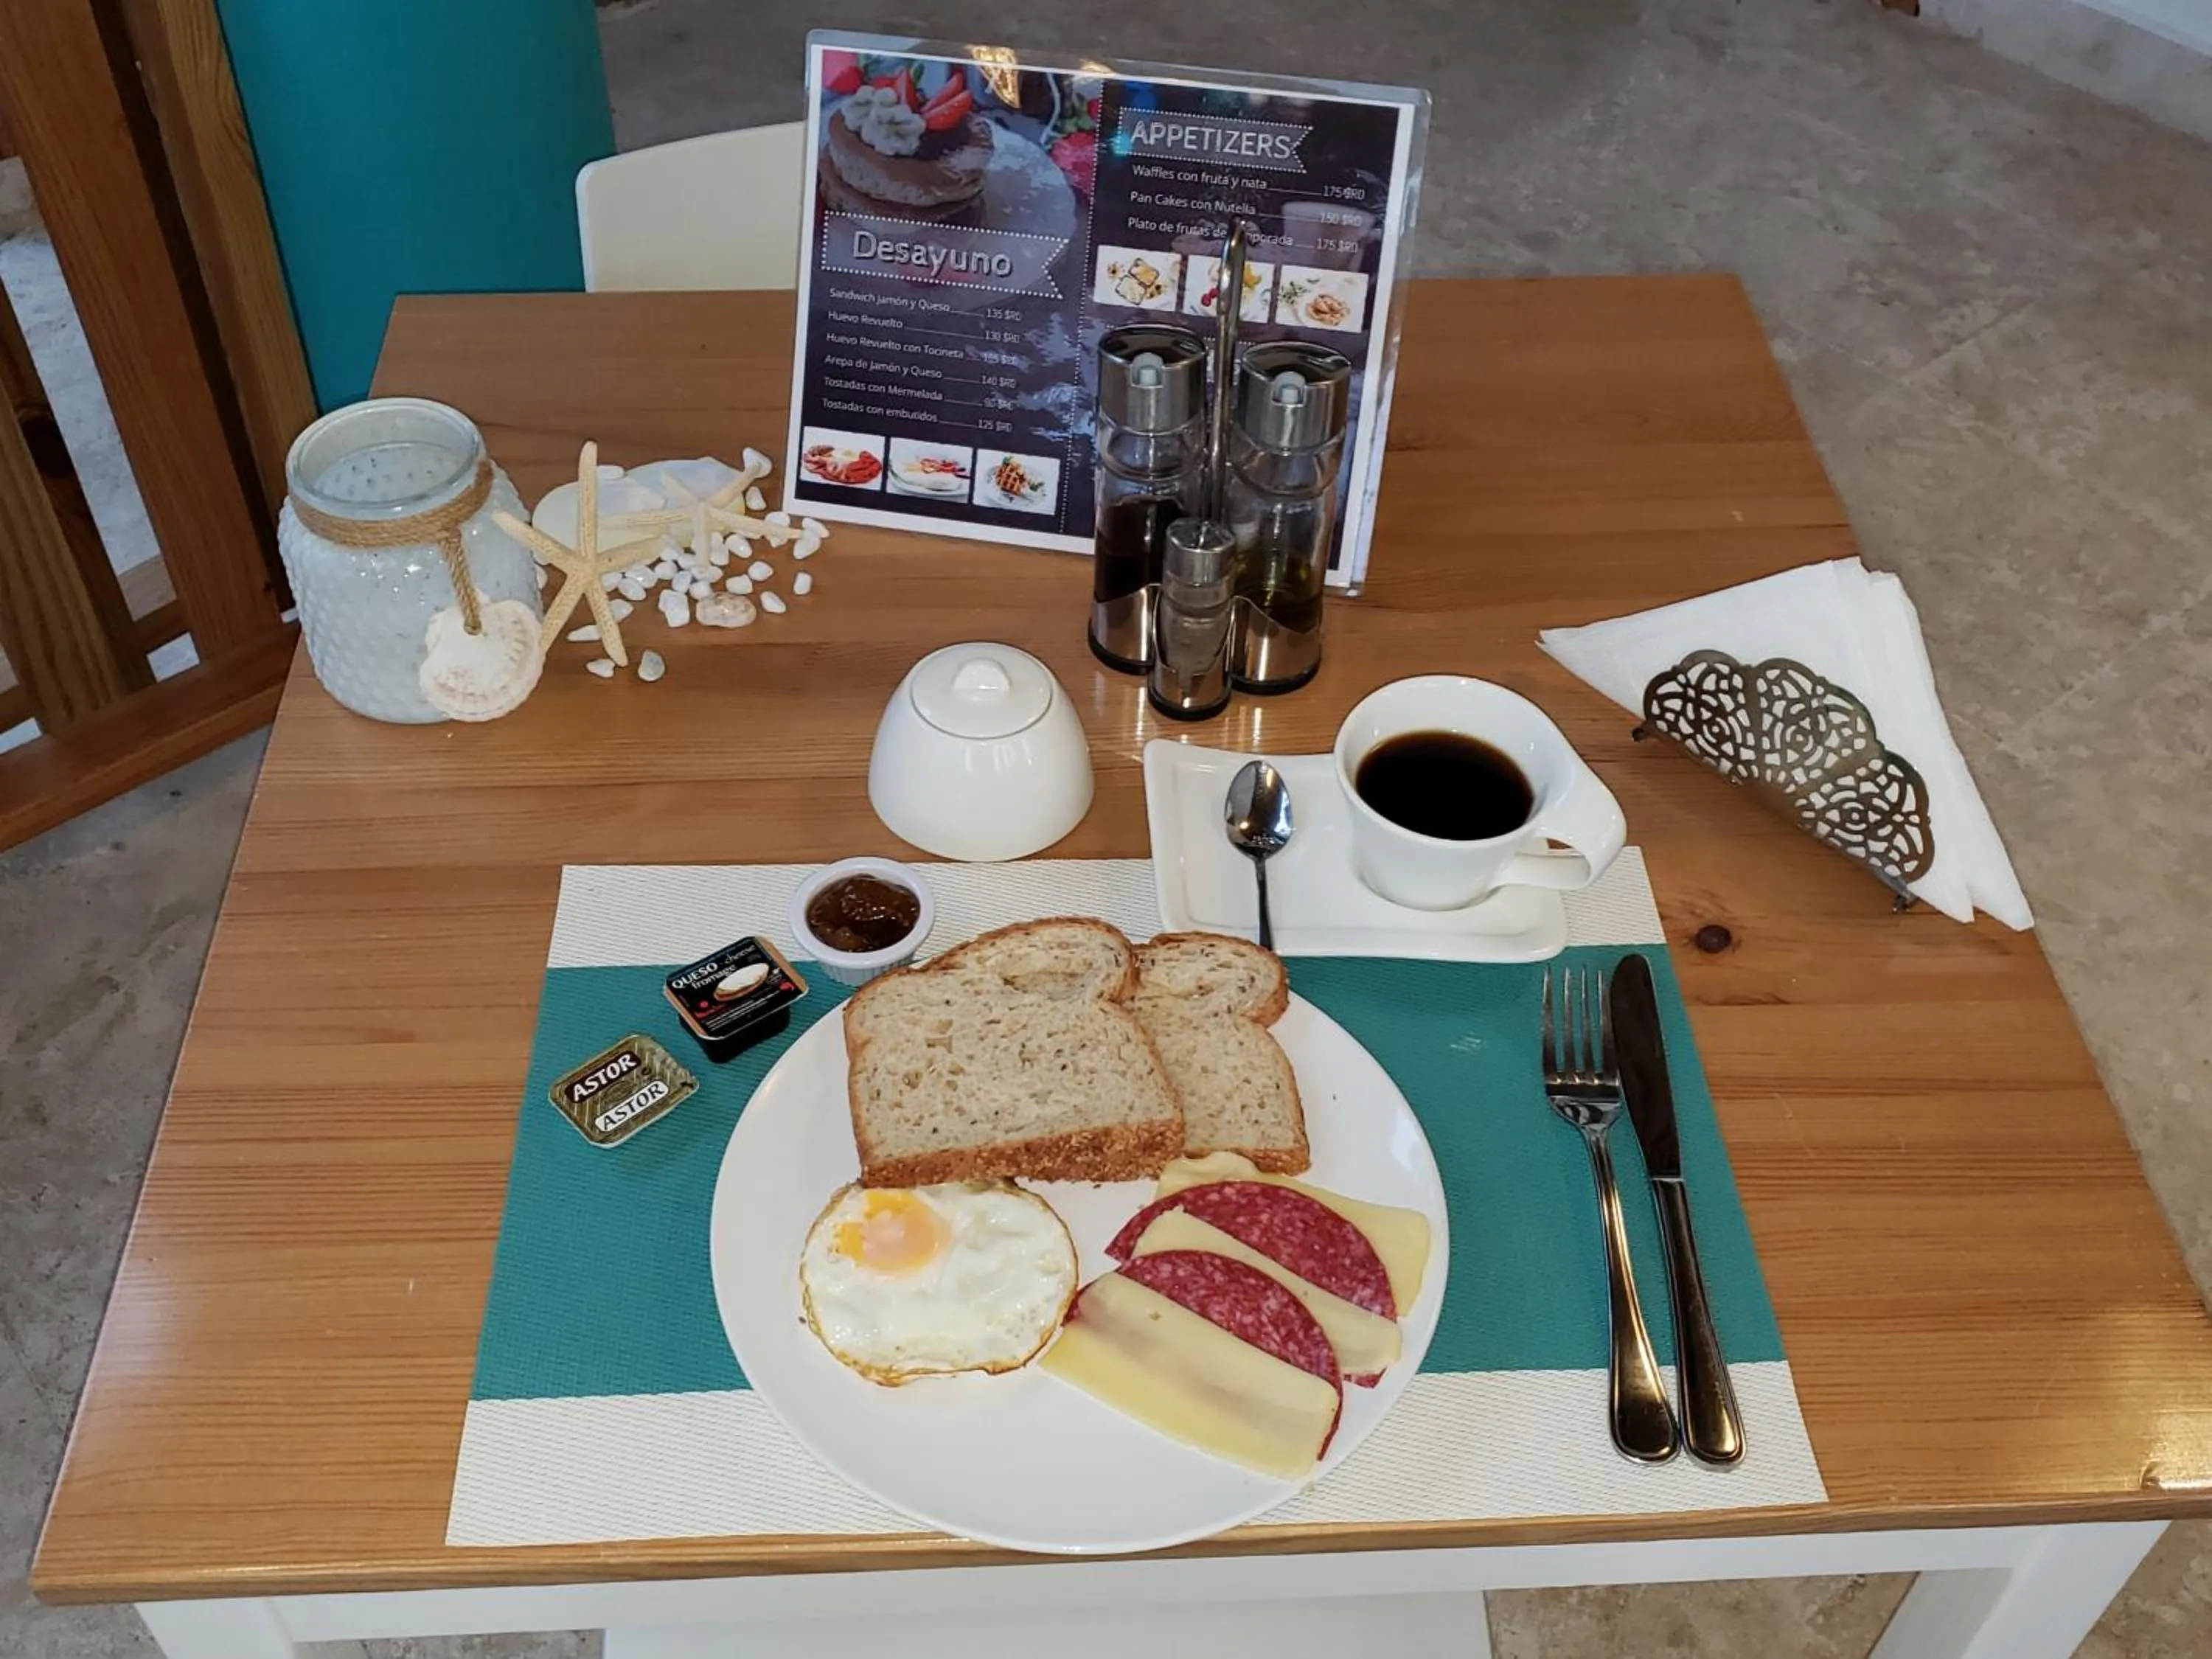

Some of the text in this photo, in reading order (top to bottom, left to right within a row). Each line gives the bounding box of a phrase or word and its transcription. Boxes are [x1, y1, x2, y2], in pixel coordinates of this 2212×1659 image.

[1131, 120, 1290, 159] APPETIZERS
[1133, 164, 1175, 179] Waffles
[1177, 172, 1198, 182] con
[1201, 172, 1229, 185] fruta
[1231, 177, 1239, 189] y
[1241, 179, 1267, 189] nata
[1324, 185, 1342, 198] 175
[1130, 191, 1152, 204] Pan
[1155, 194, 1189, 207] Cakes
[1191, 201, 1211, 210] con
[1214, 201, 1256, 214] Nutella
[1128, 217, 1157, 231] Plato
[1159, 222, 1174, 232] de
[1176, 222, 1210, 237] frutas
[1213, 227, 1228, 238] de
[853, 231, 1012, 277] Desayuno
[830, 288, 875, 302] Sandwich
[909, 299, 916, 310] y
[918, 299, 950, 312] Queso
[828, 310, 859, 323] Huevo
[861, 315, 903, 328] Revuelto
[826, 333, 858, 345] Huevo
[860, 337, 901, 350] Revuelto
[902, 344, 921, 353] con
[924, 344, 964, 358] Tocineta
[825, 355, 853, 367] Arepa
[855, 358, 868, 369] de
[902, 366, 909, 377] y
[911, 366, 943, 378] Queso
[824, 377, 866, 391] Tostadas
[868, 384, 885, 393] con
[888, 385, 943, 400] Mermelada
[822, 398, 864, 412] Tostadas
[866, 406, 884, 415] con
[886, 408, 938, 422] embutidos
[672, 961, 718, 989] QUESO
[691, 964, 737, 990] fromage
[573, 1053, 637, 1102] ASTOR
[603, 1082, 665, 1130] ASTOR
